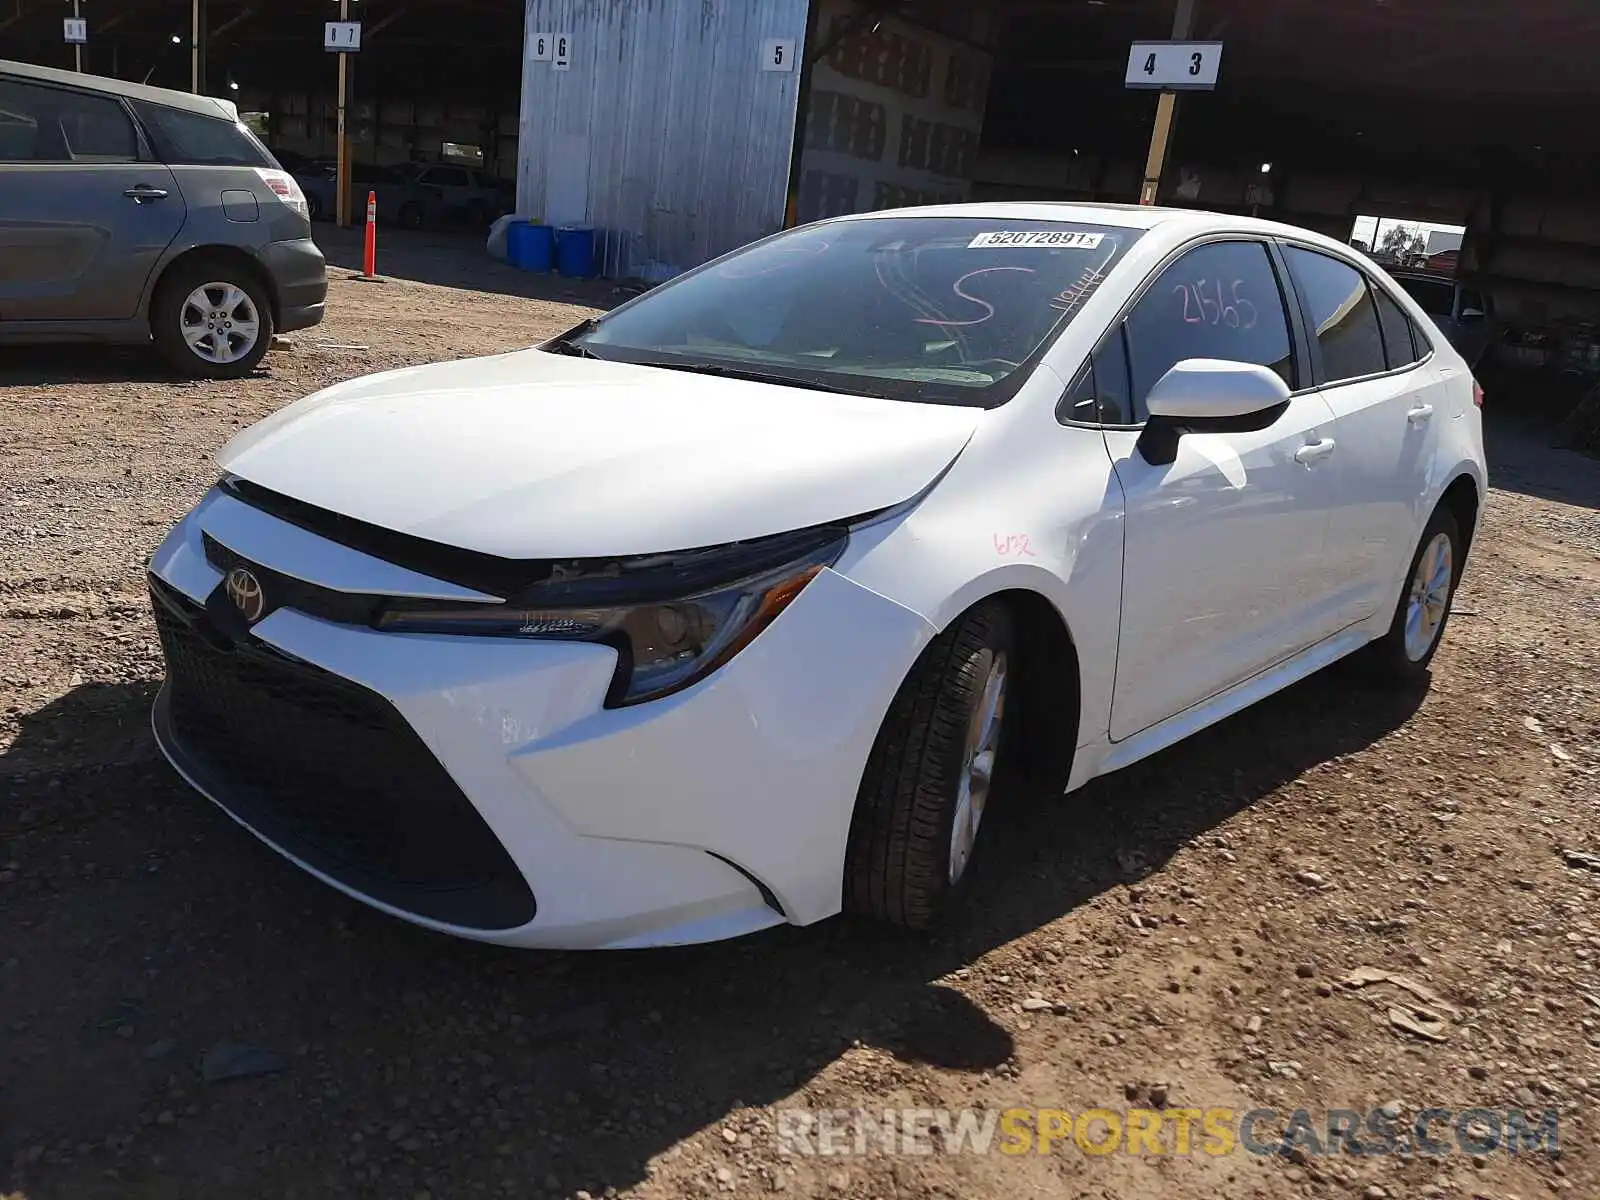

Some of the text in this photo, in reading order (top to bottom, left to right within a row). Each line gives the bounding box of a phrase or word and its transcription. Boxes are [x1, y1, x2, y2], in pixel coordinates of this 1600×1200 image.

[331, 27, 354, 43] 8 7
[537, 38, 545, 56] 6
[558, 37, 566, 57] G
[774, 45, 783, 65] 5
[1143, 51, 1202, 76] 4 3
